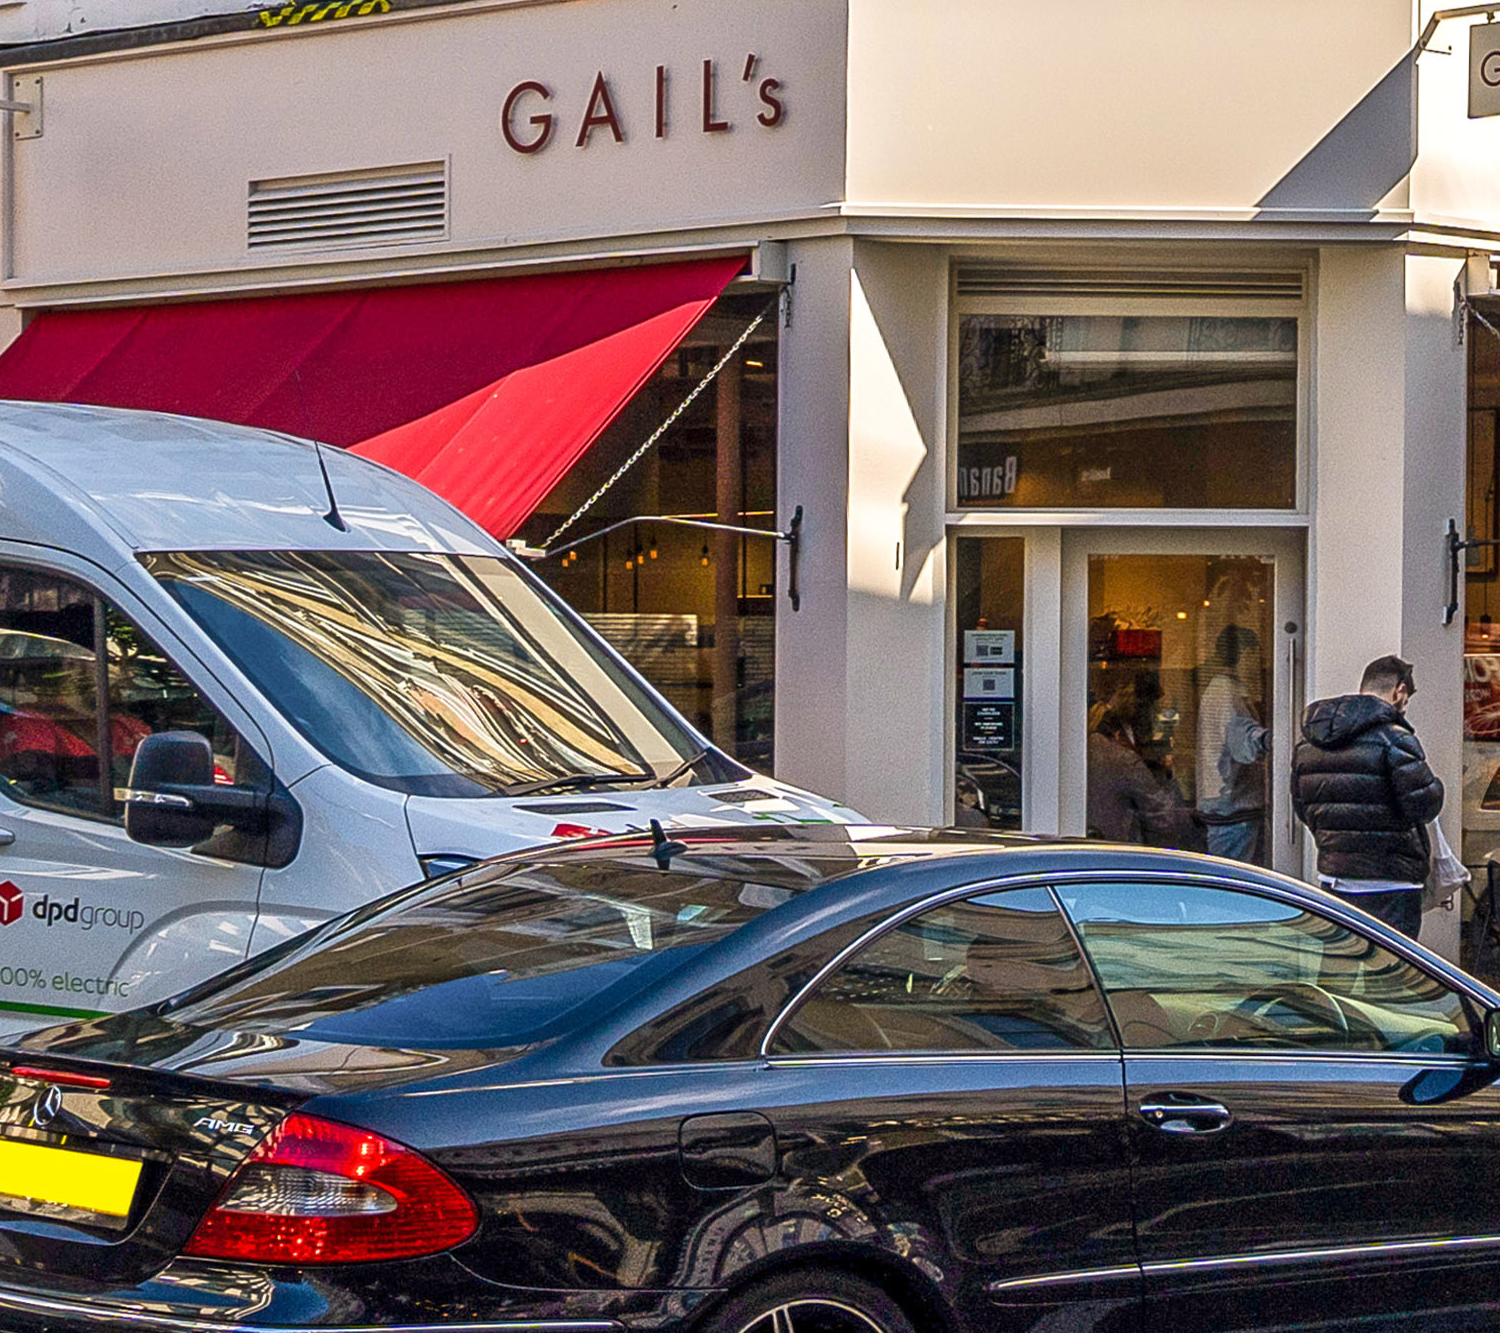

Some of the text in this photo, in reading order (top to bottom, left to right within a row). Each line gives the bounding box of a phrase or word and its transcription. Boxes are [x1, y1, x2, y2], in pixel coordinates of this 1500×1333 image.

[501, 52, 784, 155] GAIL's
[33, 894, 145, 934] dpdgroup
[52, 971, 129, 998] electric
[193, 1117, 255, 1135] AMG
